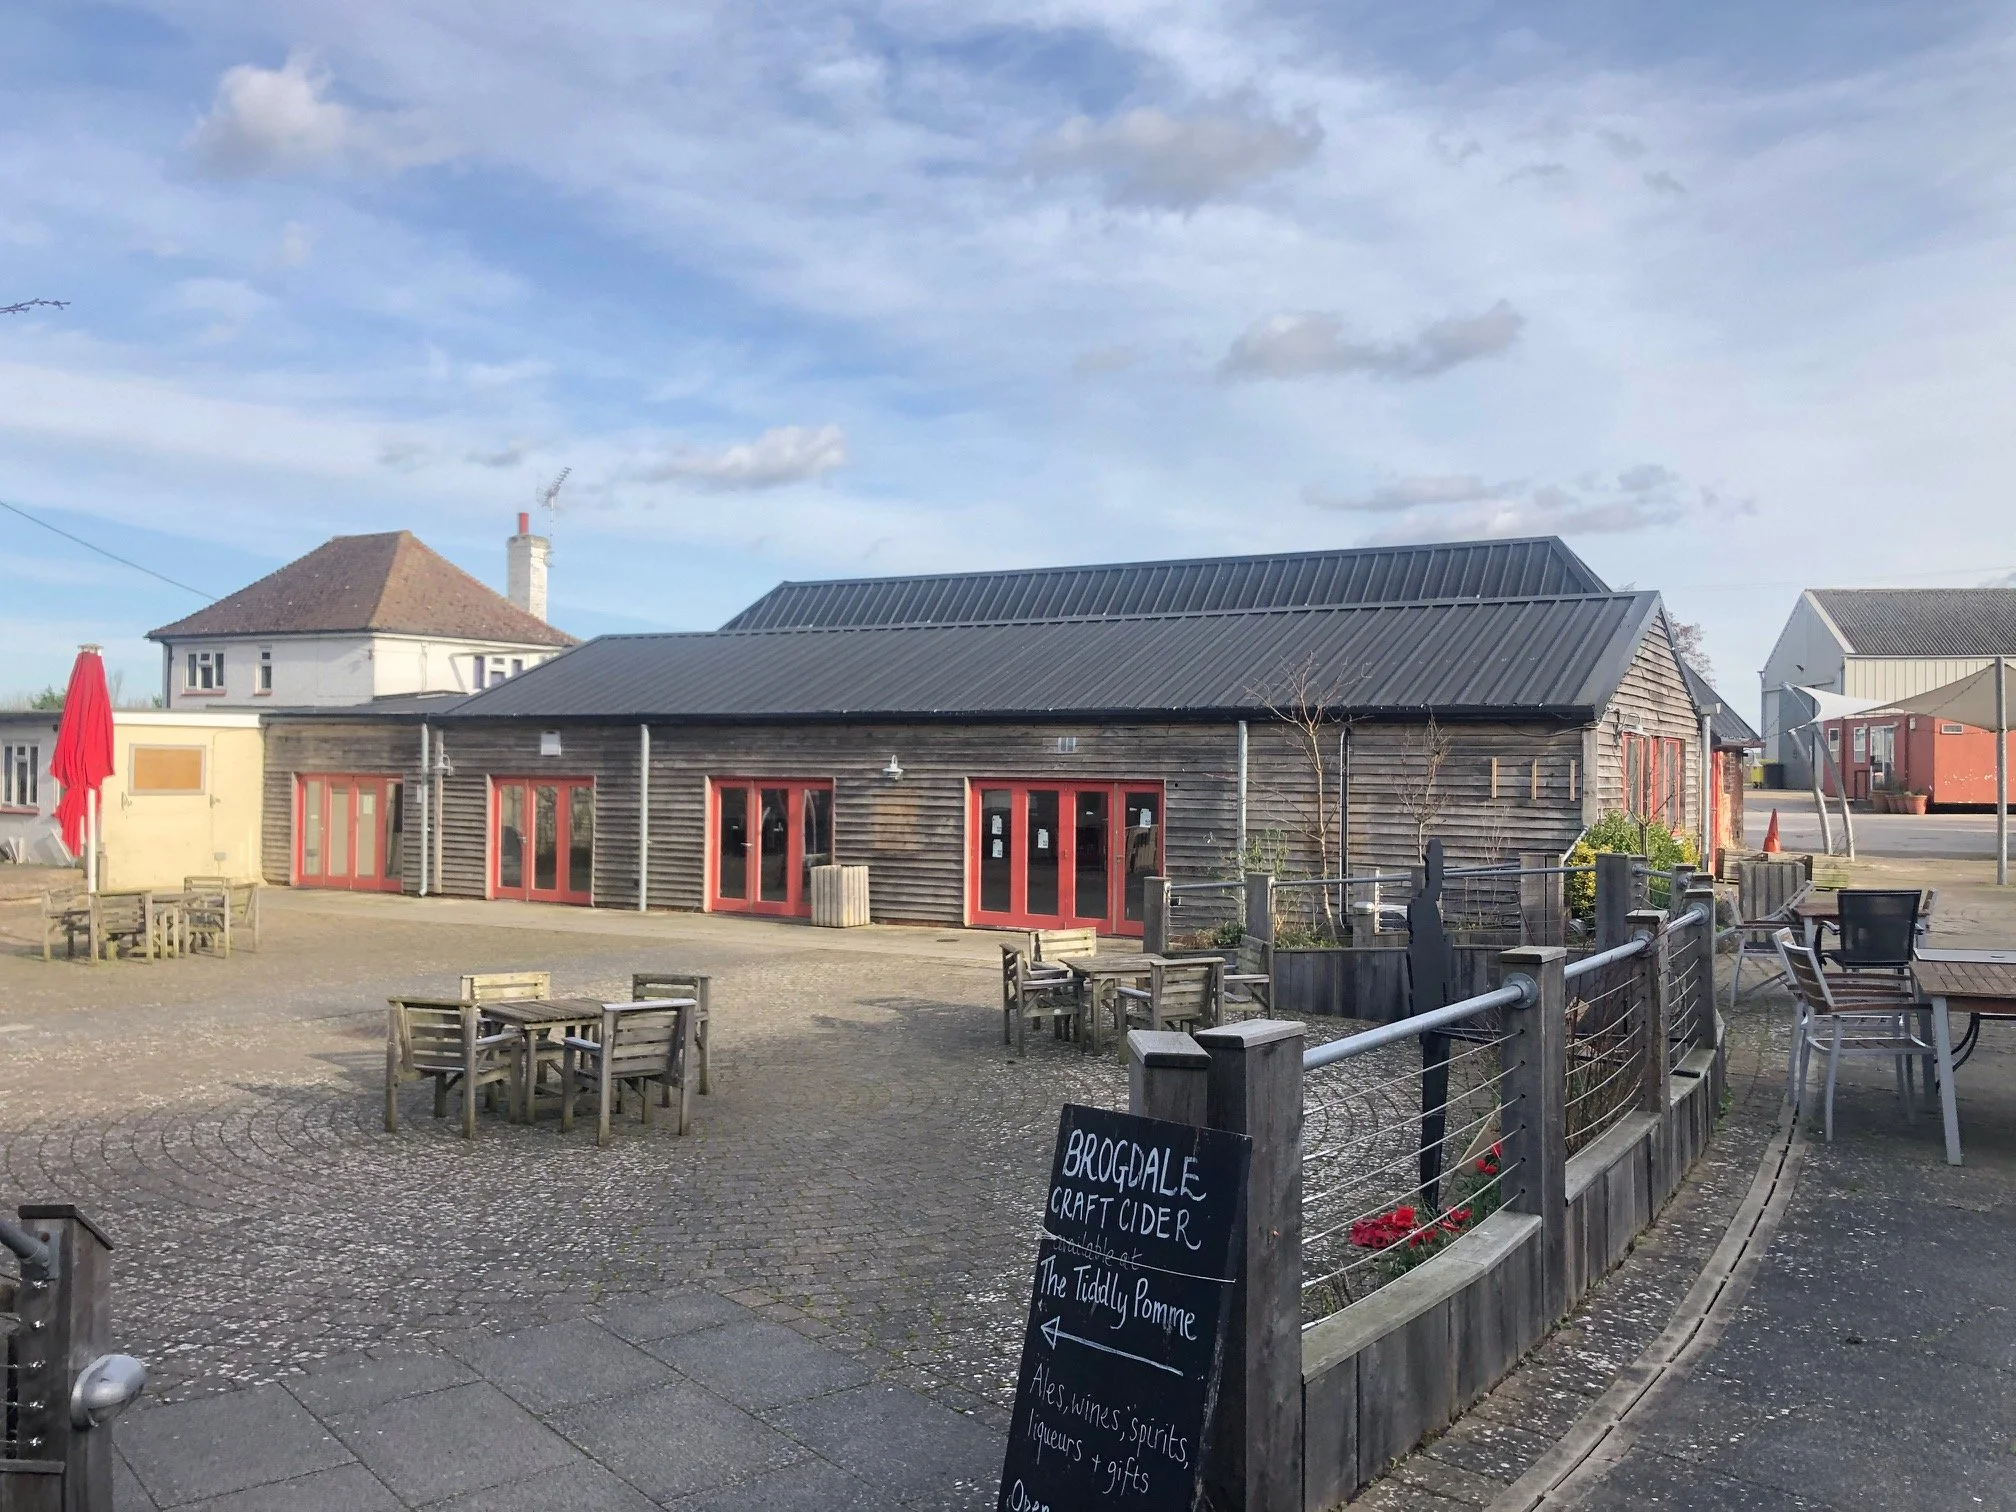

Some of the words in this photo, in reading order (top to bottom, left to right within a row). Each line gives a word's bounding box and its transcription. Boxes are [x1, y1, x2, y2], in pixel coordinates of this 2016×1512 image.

[1062, 1129, 1207, 1201] BROGDALE
[1050, 1186, 1114, 1229] CRAFT
[1119, 1198, 1201, 1250] CIDER
[1119, 1247, 1143, 1270] at
[1040, 1254, 1067, 1298] The
[1073, 1265, 1128, 1329] Tiddly
[1133, 1277, 1198, 1341] Pomme
[1027, 1408, 1083, 1465] liqueurs
[1102, 1456, 1150, 1496] gifts
